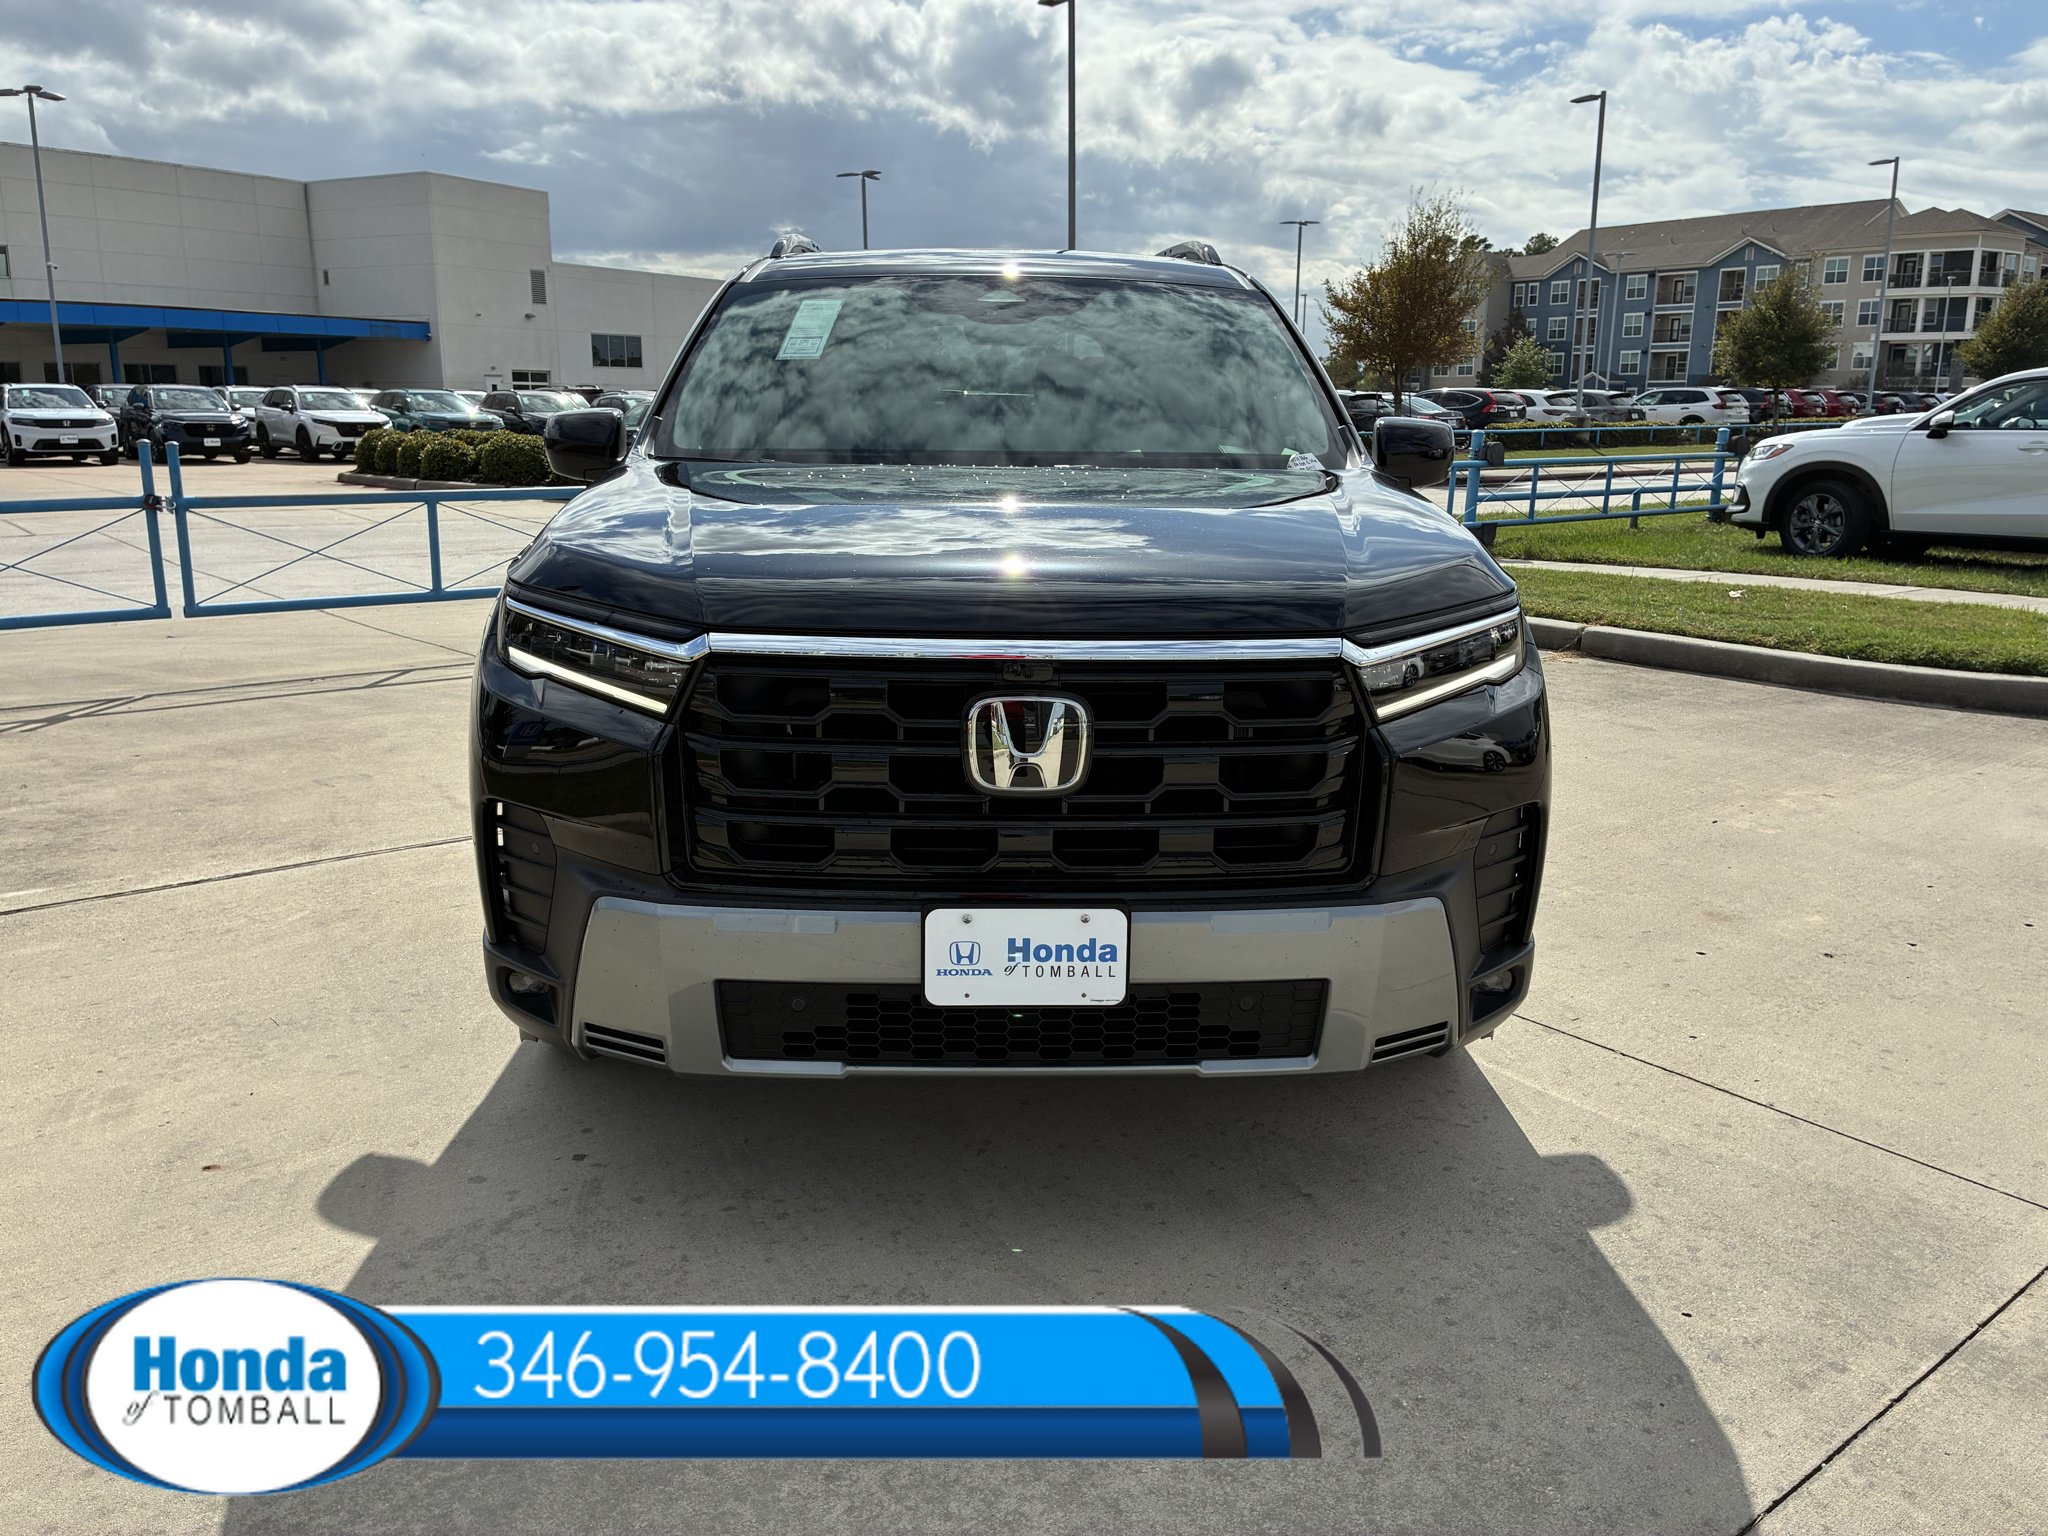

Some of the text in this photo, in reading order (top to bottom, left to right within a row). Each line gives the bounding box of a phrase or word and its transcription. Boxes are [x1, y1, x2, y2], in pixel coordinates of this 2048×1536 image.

[1007, 937, 1118, 963] Honda
[935, 968, 994, 977] HONDA
[1004, 962, 1117, 978] of TOMBALL
